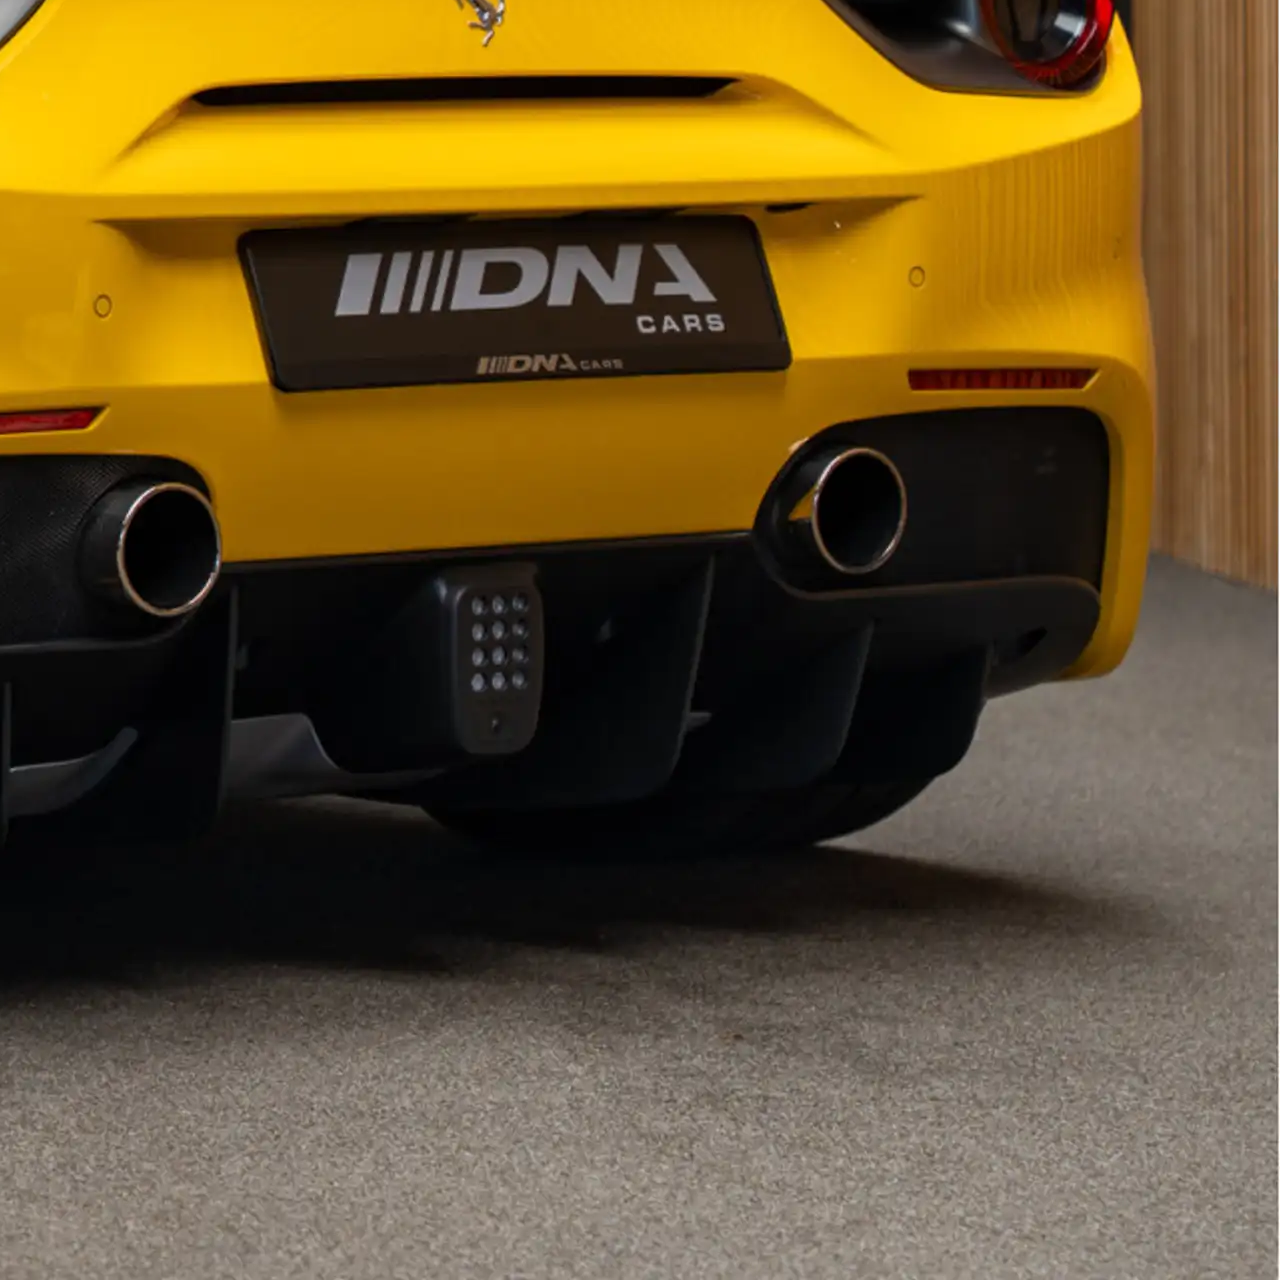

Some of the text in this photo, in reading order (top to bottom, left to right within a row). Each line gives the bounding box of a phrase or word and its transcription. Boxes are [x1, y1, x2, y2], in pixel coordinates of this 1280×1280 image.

[449, 243, 718, 311] DNA
[636, 314, 726, 334] CARS
[507, 353, 624, 373] DNA CARS
